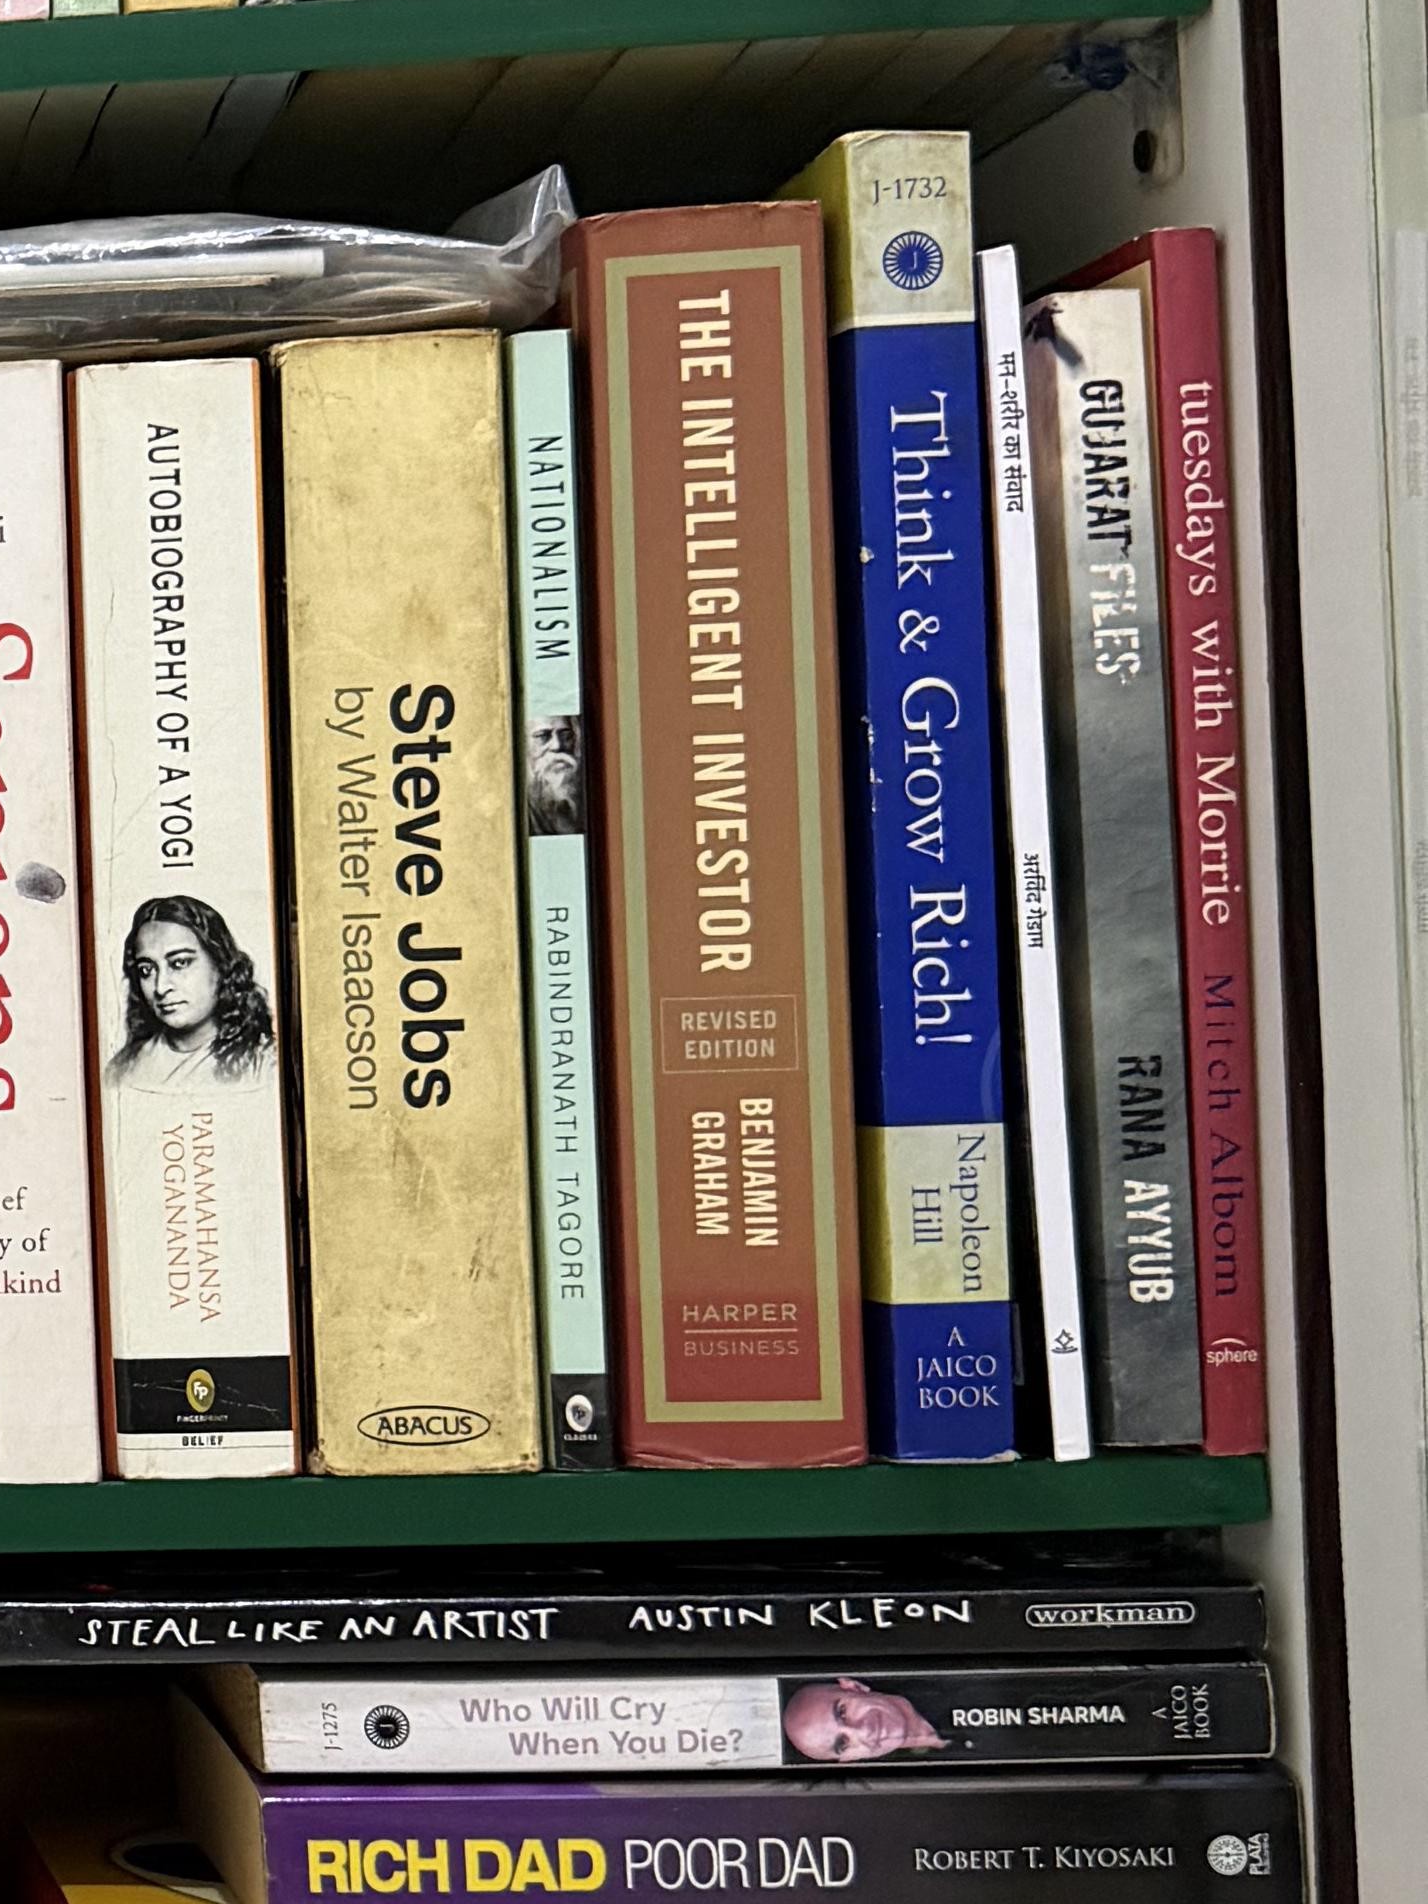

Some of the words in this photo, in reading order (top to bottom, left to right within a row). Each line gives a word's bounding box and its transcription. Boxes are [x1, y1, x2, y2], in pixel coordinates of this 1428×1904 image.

[870, 171, 947, 205] J-1732
[889, 386, 948, 590] Think
[1174, 380, 1218, 602] tuesdays
[896, 611, 934, 648] &
[1189, 617, 1225, 726] with
[332, 686, 364, 742] by
[389, 681, 455, 901] Steve
[900, 672, 964, 862] Grow
[334, 750, 375, 901] Walter
[1196, 737, 1237, 928] Morrie
[910, 881, 975, 1051] Rich!
[341, 911, 380, 1113] Isaacson
[396, 920, 465, 1113] Jobs
[680, 1009, 778, 1036] REVISED
[683, 1036, 776, 1062] EDITION
[1206, 1345, 1257, 1367] sphere
[375, 1414, 474, 1437] ABACUS
[79, 1611, 211, 1650] STEAL
[227, 1616, 317, 1643] LIKE
[340, 1612, 395, 1641] AN
[412, 1606, 559, 1642] ARTIST
[1033, 1601, 1189, 1626] workman
[306, 1836, 451, 1896] RICH
[465, 1837, 607, 1894] DAD
[624, 1840, 751, 1889] POOR
[758, 1835, 855, 1887] DAD
